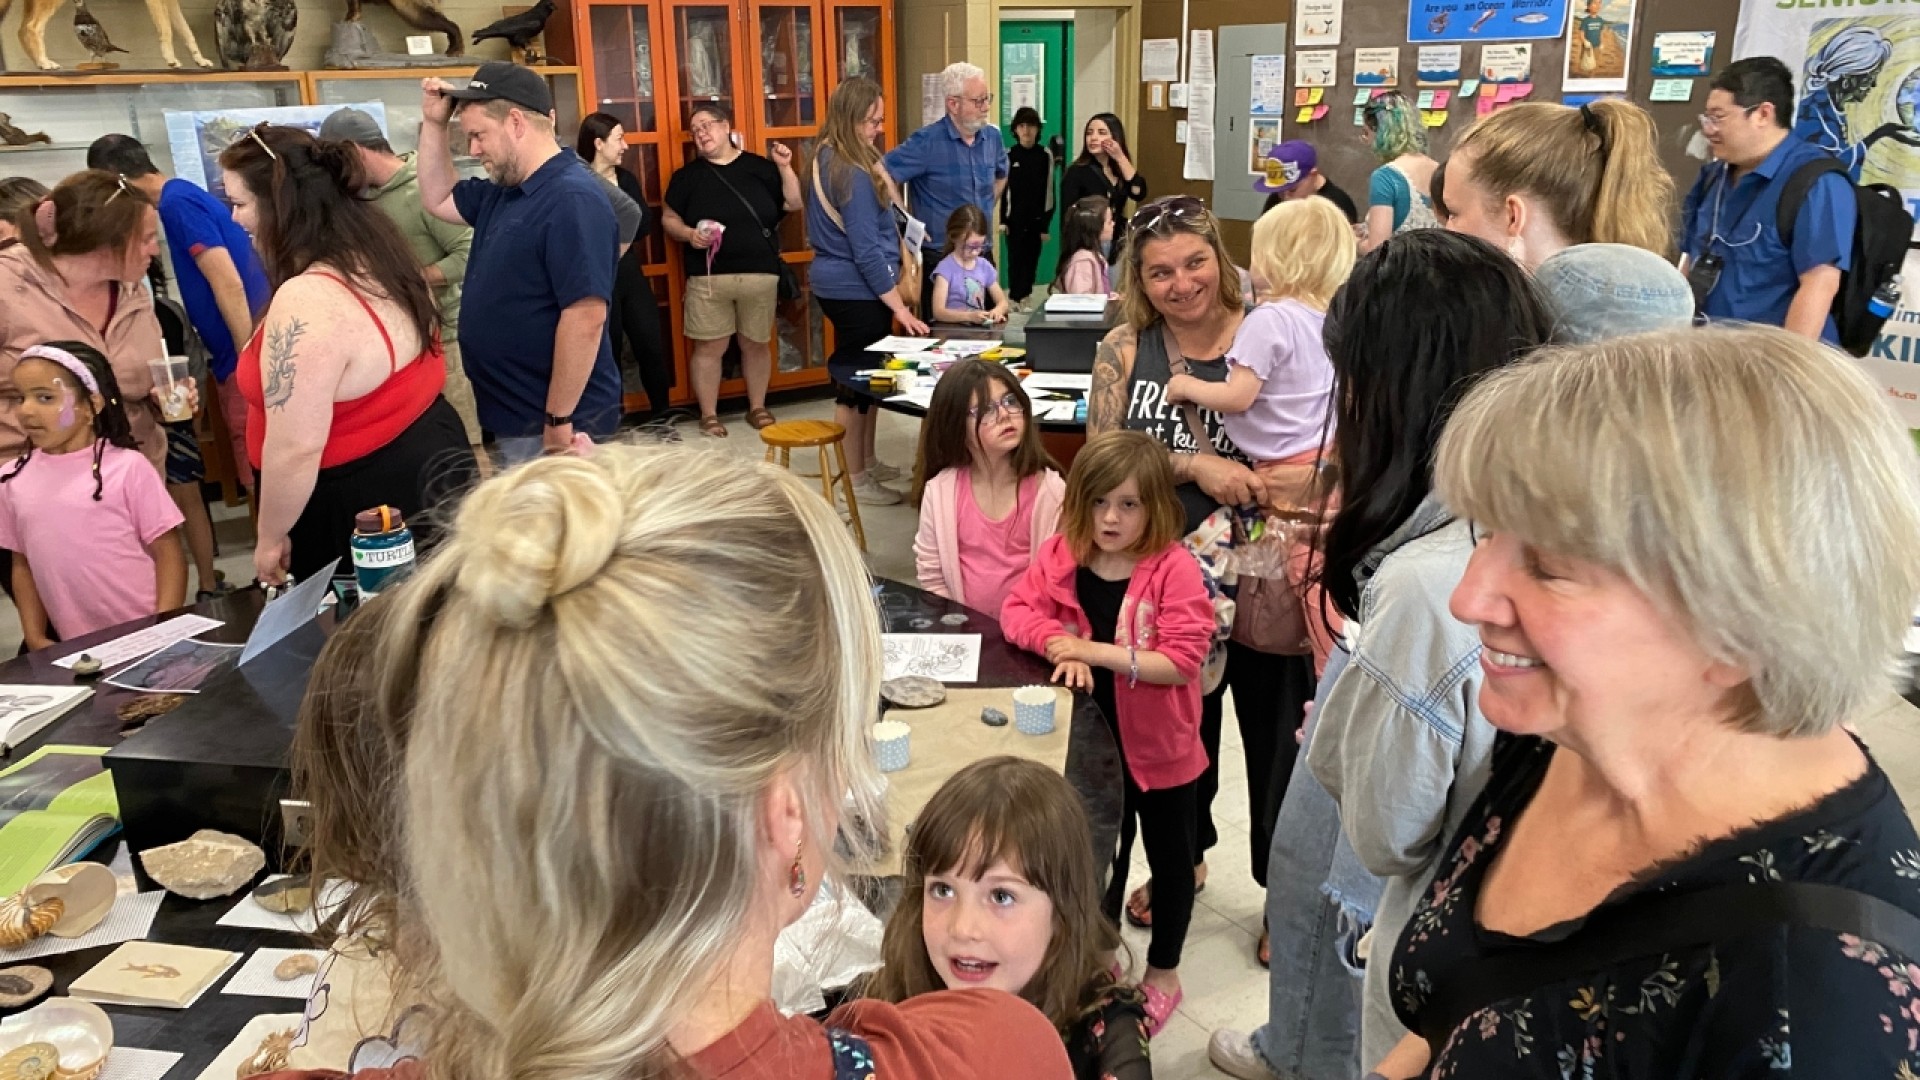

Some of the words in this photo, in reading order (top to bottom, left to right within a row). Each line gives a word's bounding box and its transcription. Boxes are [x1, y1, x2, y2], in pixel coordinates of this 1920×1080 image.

[1425, 4, 1439, 12] Are
[1442, 4, 1459, 13] you
[1464, 3, 1477, 11] an
[1478, 1, 1506, 11] Ocean
